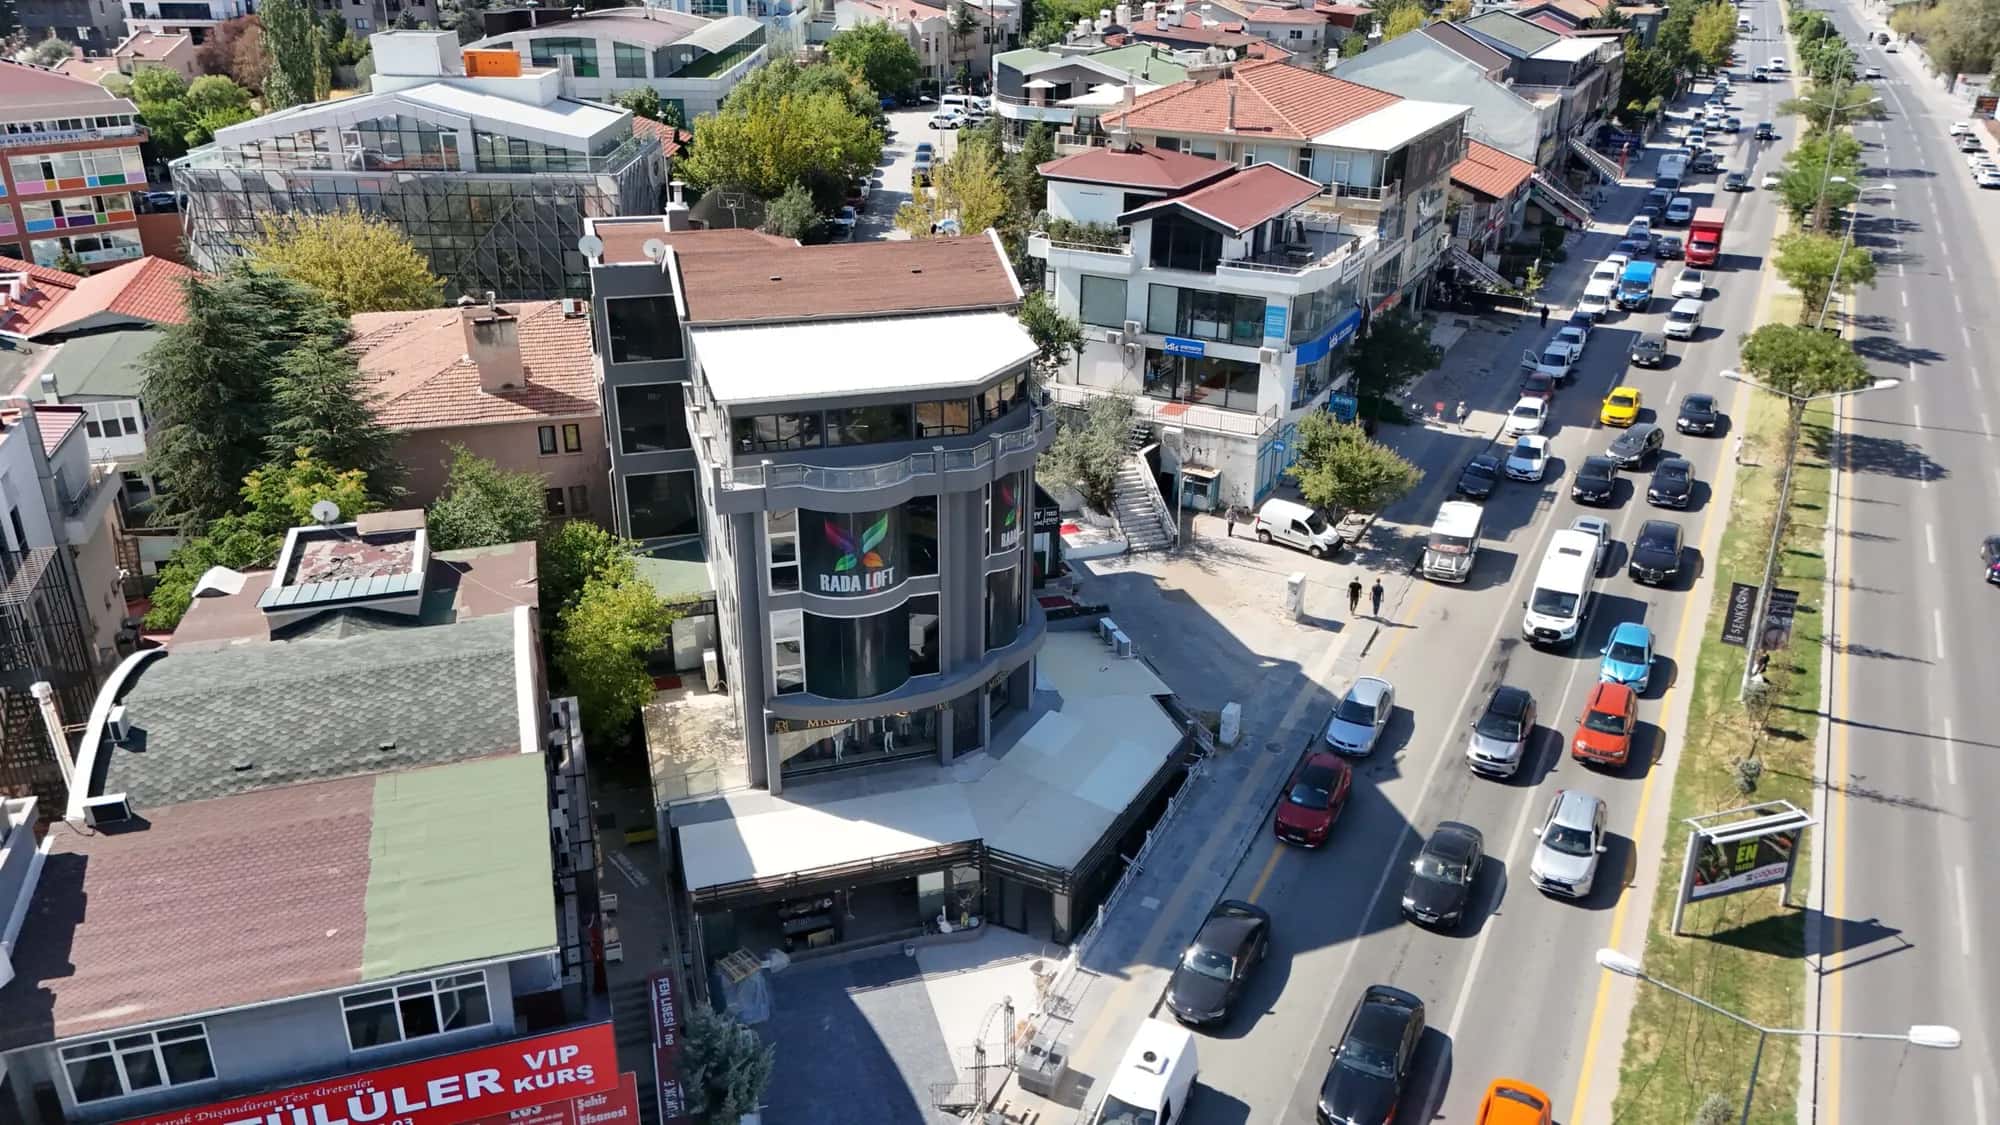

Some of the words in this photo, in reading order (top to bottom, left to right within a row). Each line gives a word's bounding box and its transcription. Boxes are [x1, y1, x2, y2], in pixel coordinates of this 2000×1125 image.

[820, 573, 861, 592] RADA
[865, 566, 895, 590] LOFT
[657, 977, 671, 997] FEN
[522, 1045, 579, 1070] VIP
[513, 1064, 595, 1094] KURS
[280, 1092, 309, 1107] Test
